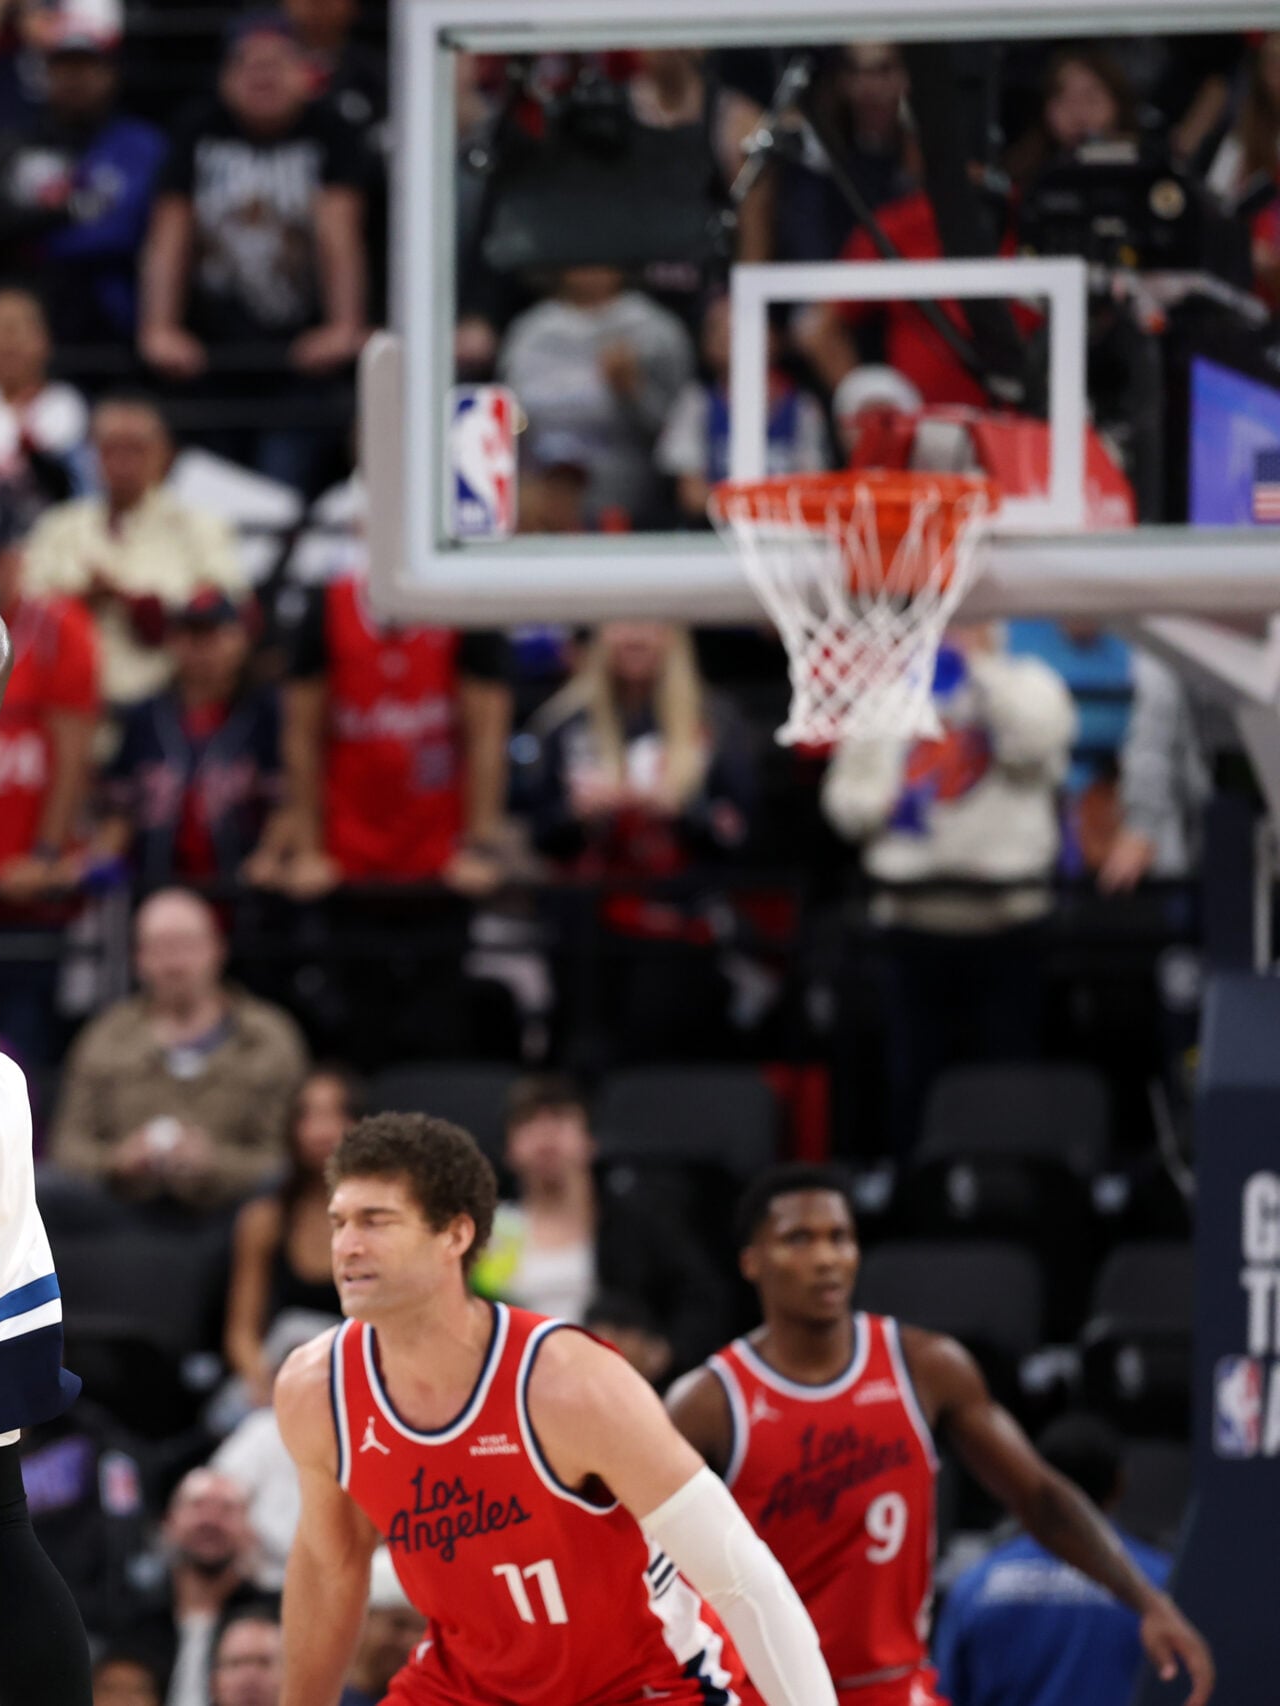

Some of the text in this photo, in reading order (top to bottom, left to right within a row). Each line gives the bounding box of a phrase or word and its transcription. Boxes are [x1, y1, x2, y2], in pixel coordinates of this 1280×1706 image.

[410, 1466, 472, 1515] Los
[387, 1490, 532, 1562] Angeles
[864, 1491, 908, 1565] 9
[491, 1559, 569, 1625] 11
